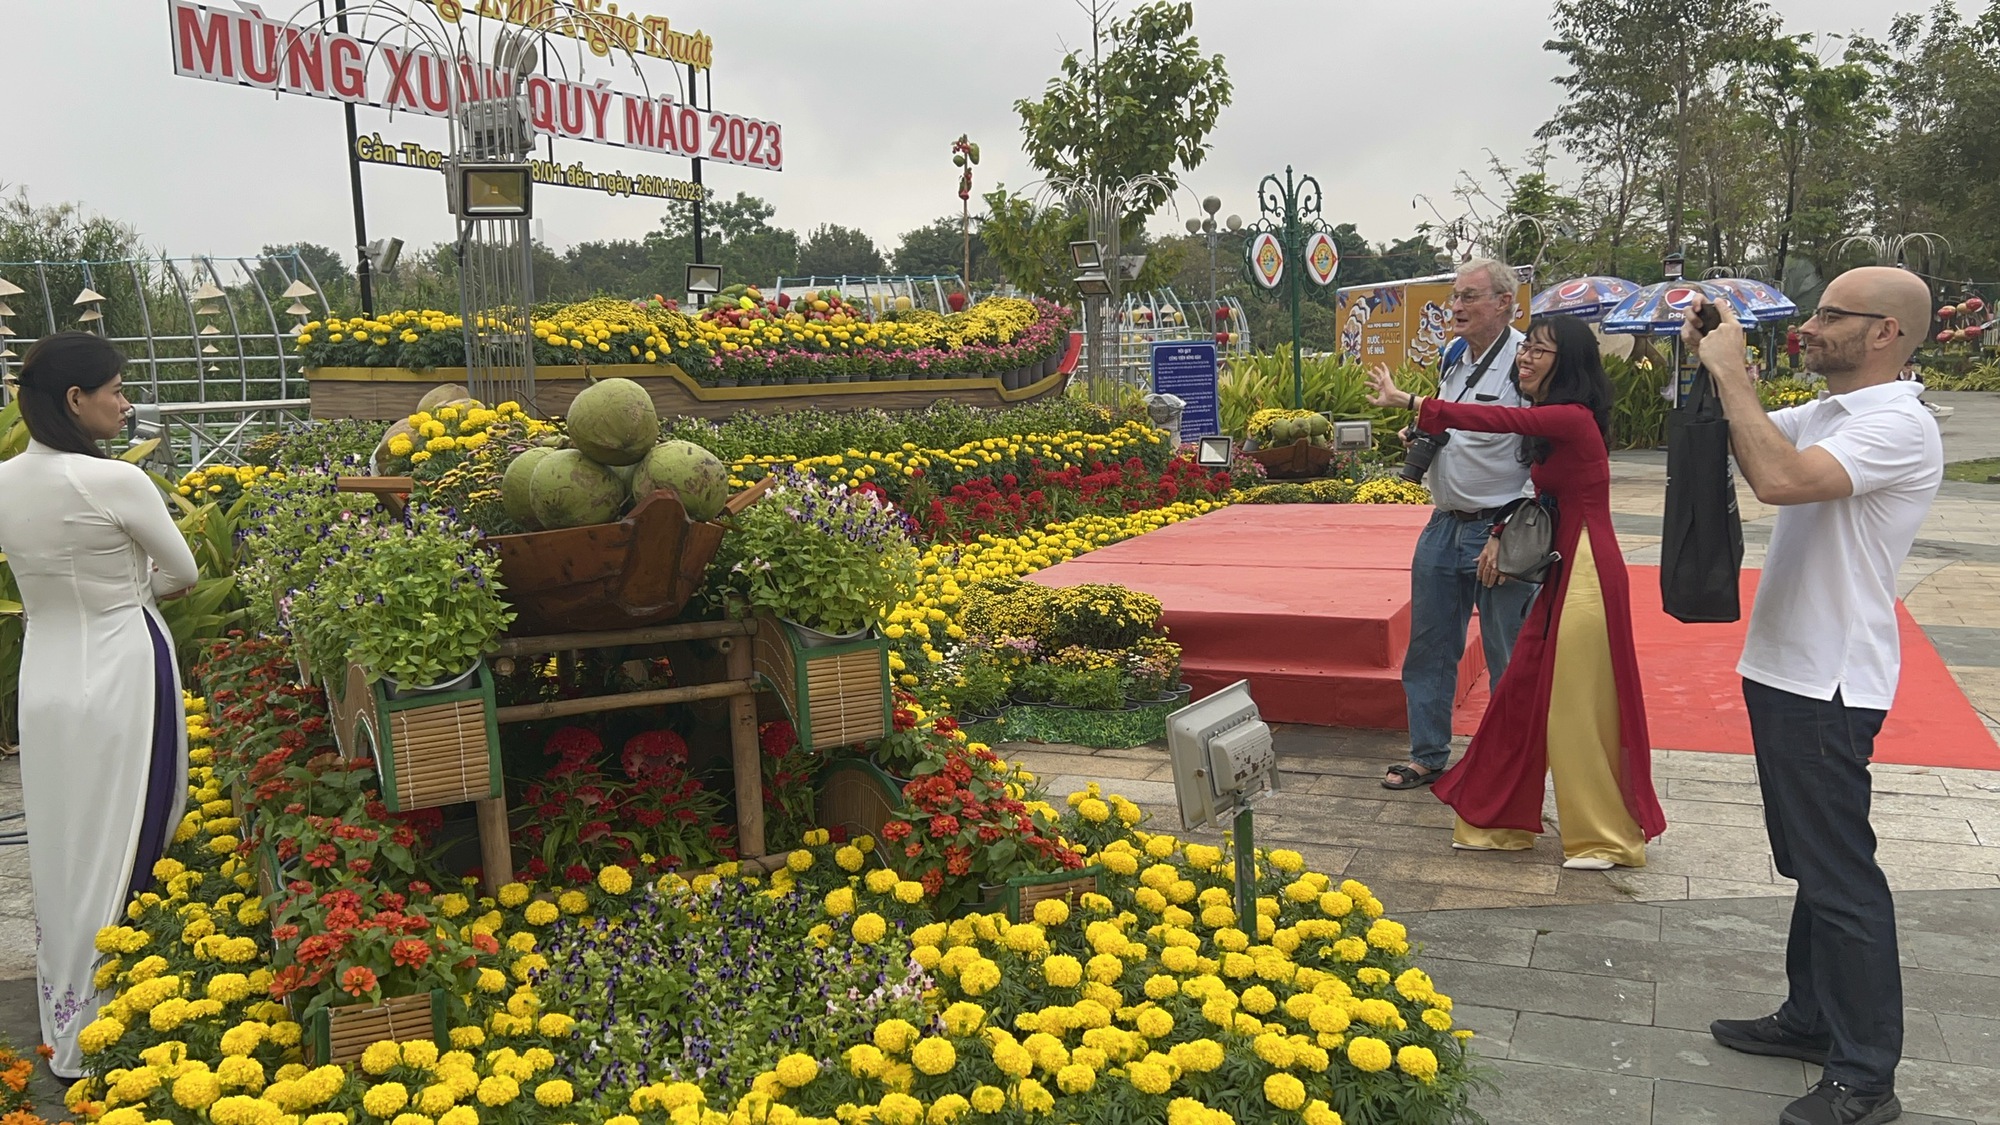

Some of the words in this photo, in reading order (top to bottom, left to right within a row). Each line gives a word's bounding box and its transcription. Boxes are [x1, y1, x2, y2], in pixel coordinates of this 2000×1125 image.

[645, 18, 711, 70] Thuật
[176, 6, 365, 99] MỪNG
[529, 77, 611, 141] QUÝ
[625, 98, 701, 155] MÃO
[709, 116, 781, 168] 2023
[356, 132, 396, 163] Cần
[402, 143, 442, 169] Thơ
[567, 162, 594, 189] đến
[636, 174, 702, 201] 26/01/2023
[1559, 298, 1584, 308] pepsi
[1668, 312, 1687, 320] pep
